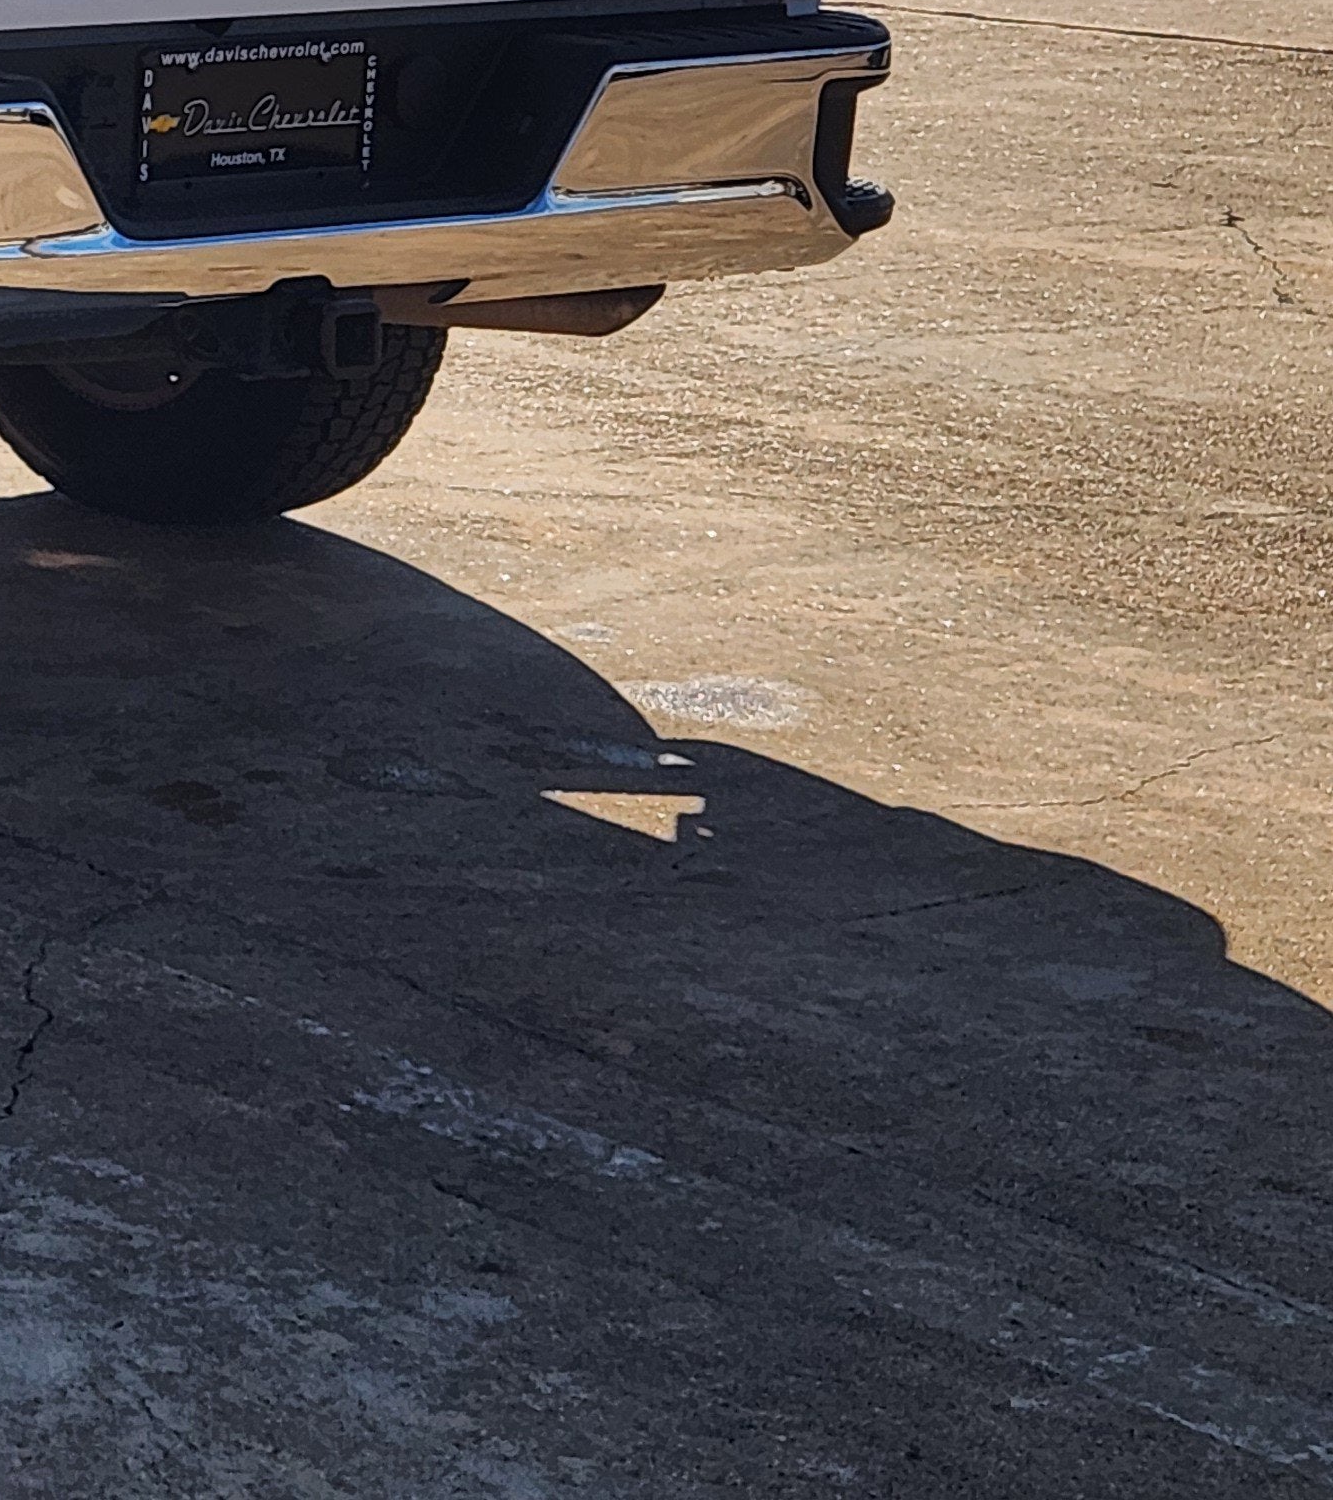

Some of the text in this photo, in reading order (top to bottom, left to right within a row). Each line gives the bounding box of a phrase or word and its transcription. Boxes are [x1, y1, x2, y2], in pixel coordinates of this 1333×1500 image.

[160, 41, 366, 70] www.davischevrolet.com
[139, 69, 153, 182] DAVIS
[247, 94, 361, 131] Chevrolet
[361, 54, 378, 172] CHEVROLET
[210, 147, 287, 168] Houston, TX
